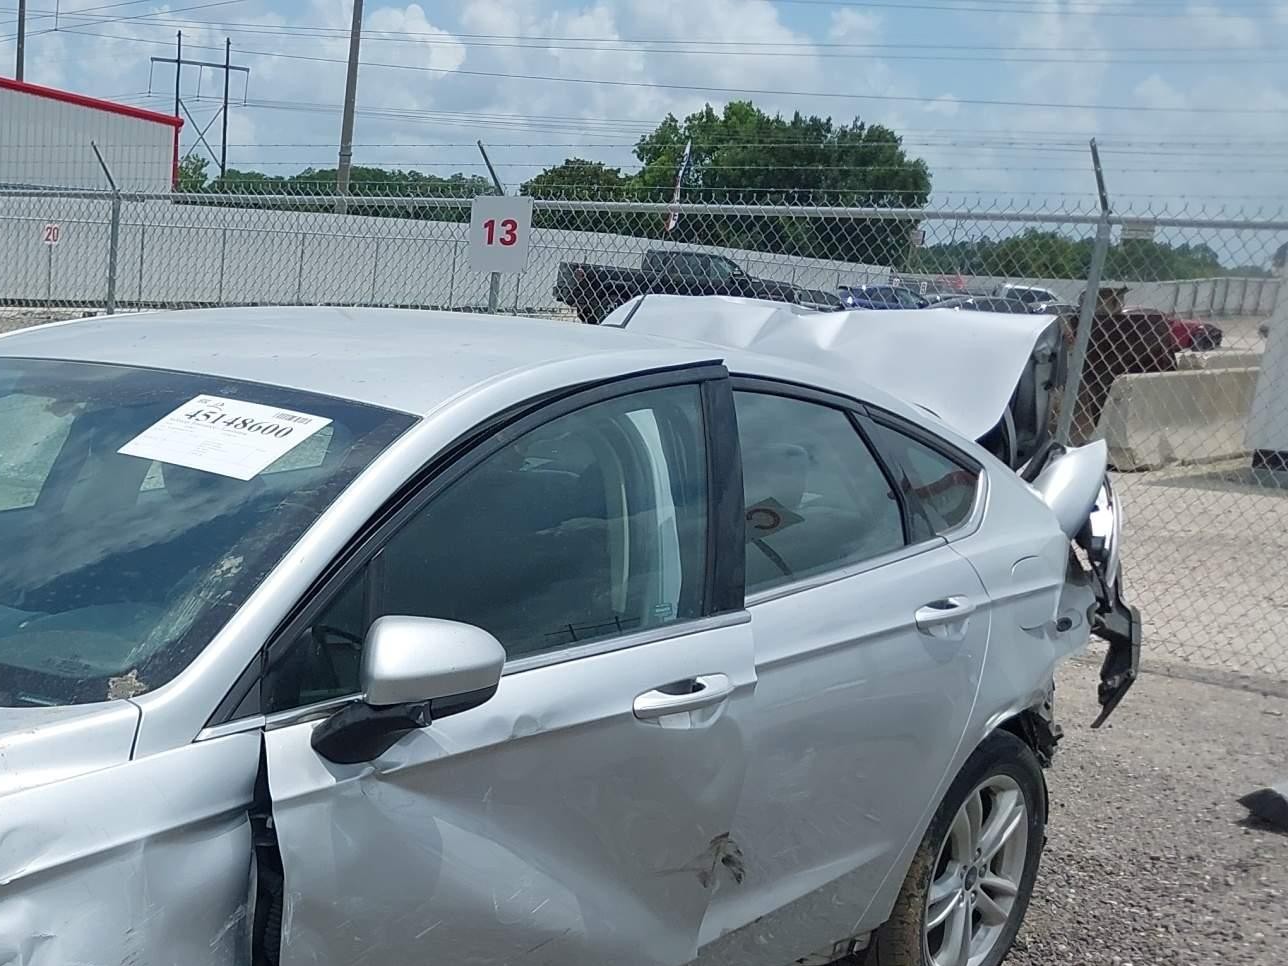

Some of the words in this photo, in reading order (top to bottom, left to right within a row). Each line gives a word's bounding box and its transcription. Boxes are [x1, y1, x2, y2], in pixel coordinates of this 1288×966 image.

[44, 226, 59, 242] 20
[483, 219, 518, 246] 13
[184, 409, 294, 439] 45148600
